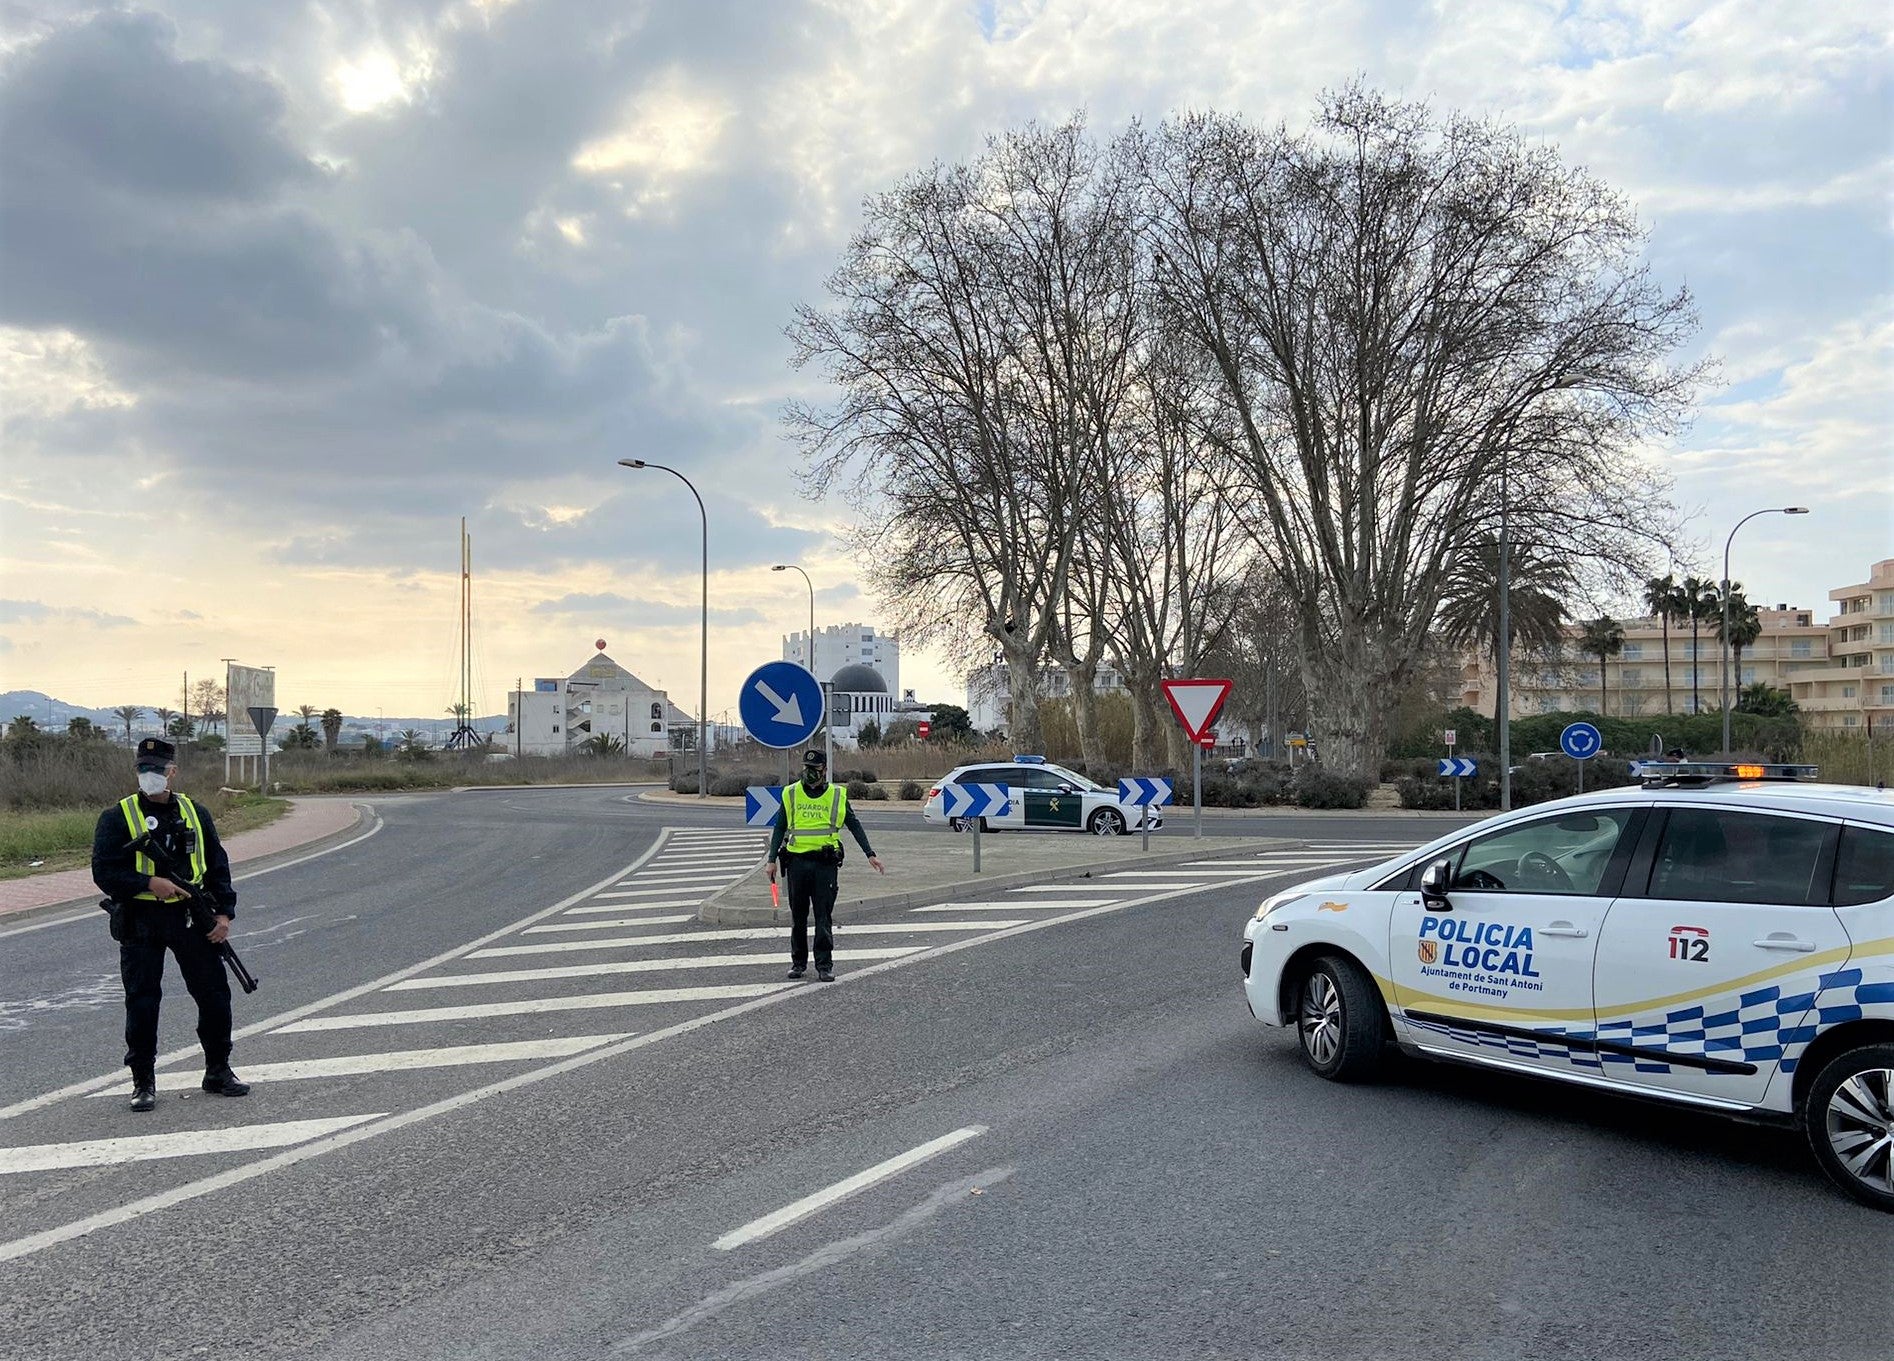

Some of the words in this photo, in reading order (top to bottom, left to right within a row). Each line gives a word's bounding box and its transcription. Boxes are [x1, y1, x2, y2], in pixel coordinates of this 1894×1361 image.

[797, 803, 829, 812] GUARDIA
[1419, 916, 1533, 950] POLICIA
[1443, 944, 1540, 977] LOCAL
[1668, 937, 1709, 962] 112
[1421, 966, 1472, 980] Ajuntament
[1474, 972, 1486, 982] de
[1487, 975, 1509, 986] Sant
[1510, 979, 1543, 991] Antoni
[1449, 981, 1460, 991] de
[1462, 983, 1508, 999] Portmany
